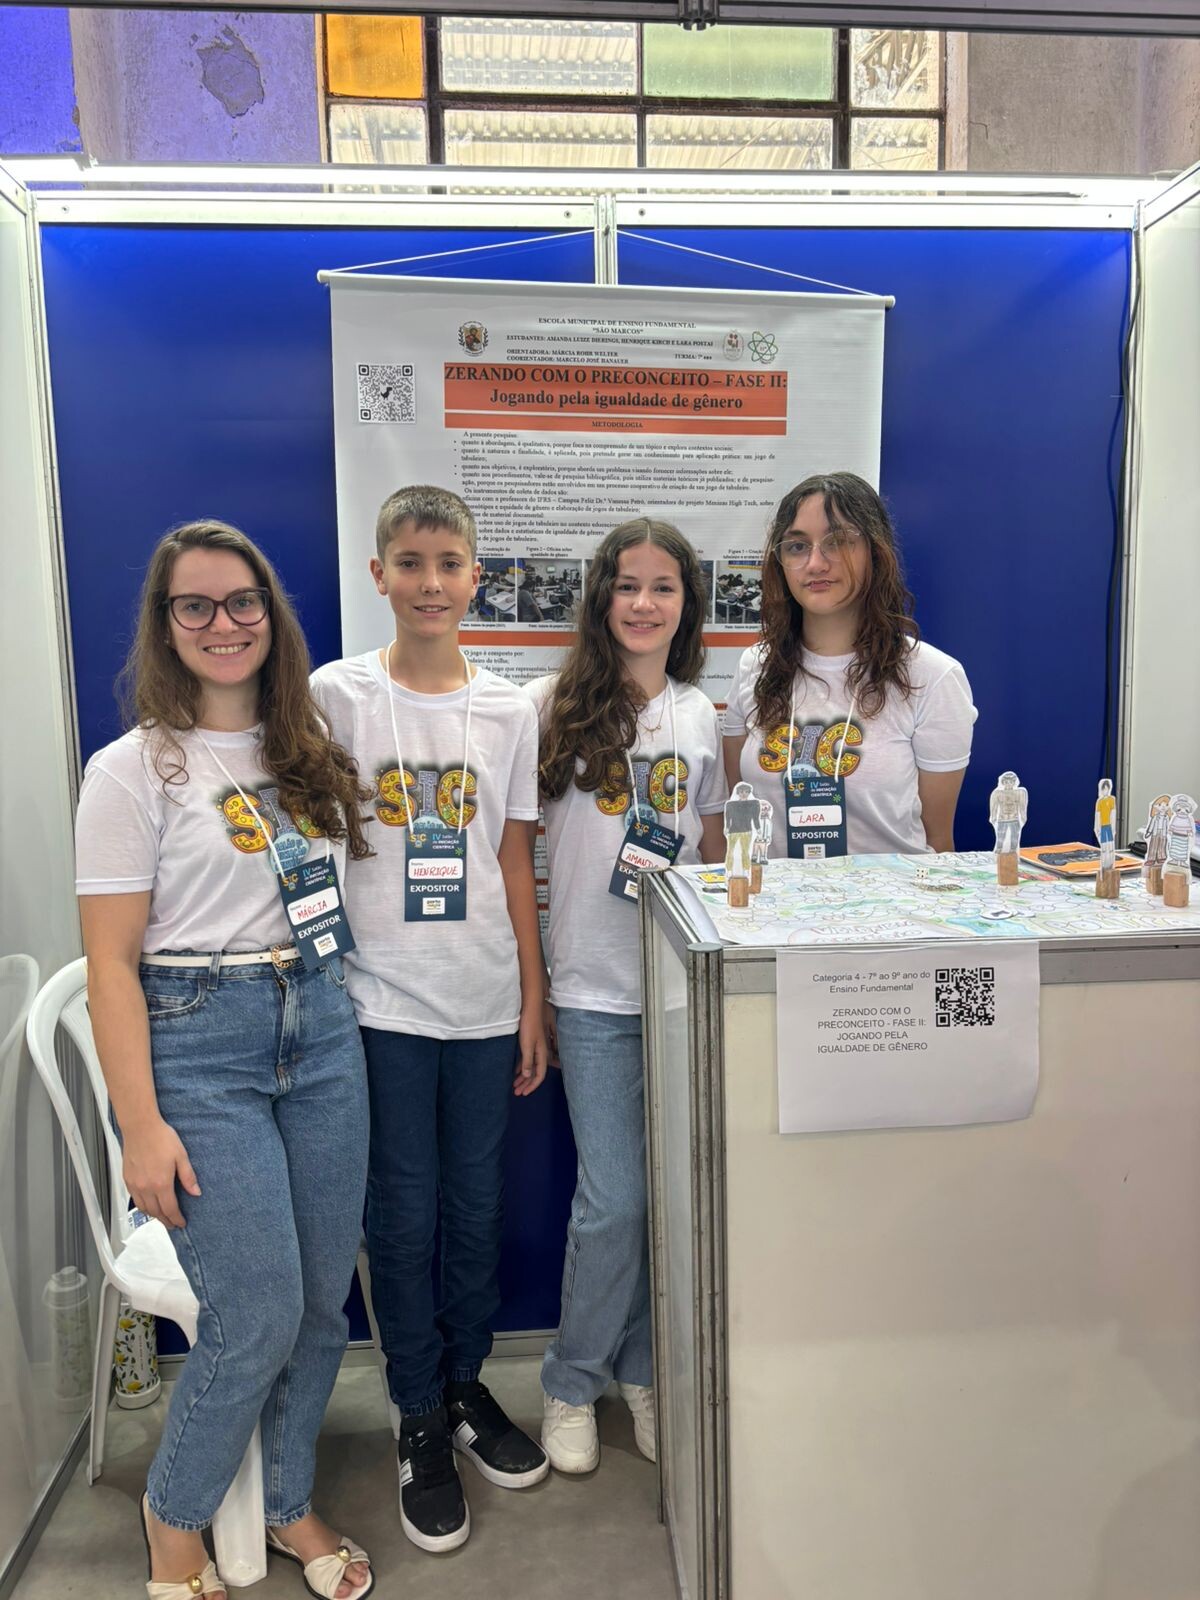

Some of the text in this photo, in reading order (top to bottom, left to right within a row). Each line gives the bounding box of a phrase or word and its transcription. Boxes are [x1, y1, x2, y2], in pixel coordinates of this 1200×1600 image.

[567, 318, 607, 326] MUNICIPAL
[621, 338, 651, 346] HENRIQUE
[586, 356, 600, 364] JOSÉ
[445, 367, 527, 382] ZERANDO
[530, 368, 569, 383] COM
[574, 370, 587, 384] O
[591, 370, 709, 387] PRECONCEITO
[726, 374, 765, 388] FASE
[770, 374, 787, 388] II:
[490, 388, 743, 411] Jogando pela igualdade de gênero
[592, 420, 644, 428] METODOLOGIA
[758, 722, 863, 777] SIC
[376, 769, 477, 828] SIC
[799, 813, 825, 824] LARA
[409, 834, 427, 842] SIC
[792, 832, 839, 840] EXPOSITOR
[302, 867, 311, 878] IV
[414, 866, 458, 877] HENRIQUE
[410, 884, 460, 892] EXPOSITOR
[297, 900, 328, 920] MÁRCIA
[298, 914, 342, 939] EXPOSITOR
[812, 973, 852, 984] Categoria
[920, 971, 930, 979] do
[830, 984, 914, 993] Ensino Fundamental
[832, 1007, 911, 1017] ZERANDO COM O
[818, 1020, 885, 1029] PRECONCEITO
[892, 1019, 916, 1028] FASE
[918, 1018, 926, 1027] II:
[836, 1031, 908, 1041] JOGANDO PELA
[818, 1040, 928, 1054] IGUALDADE DE GÊNERO
